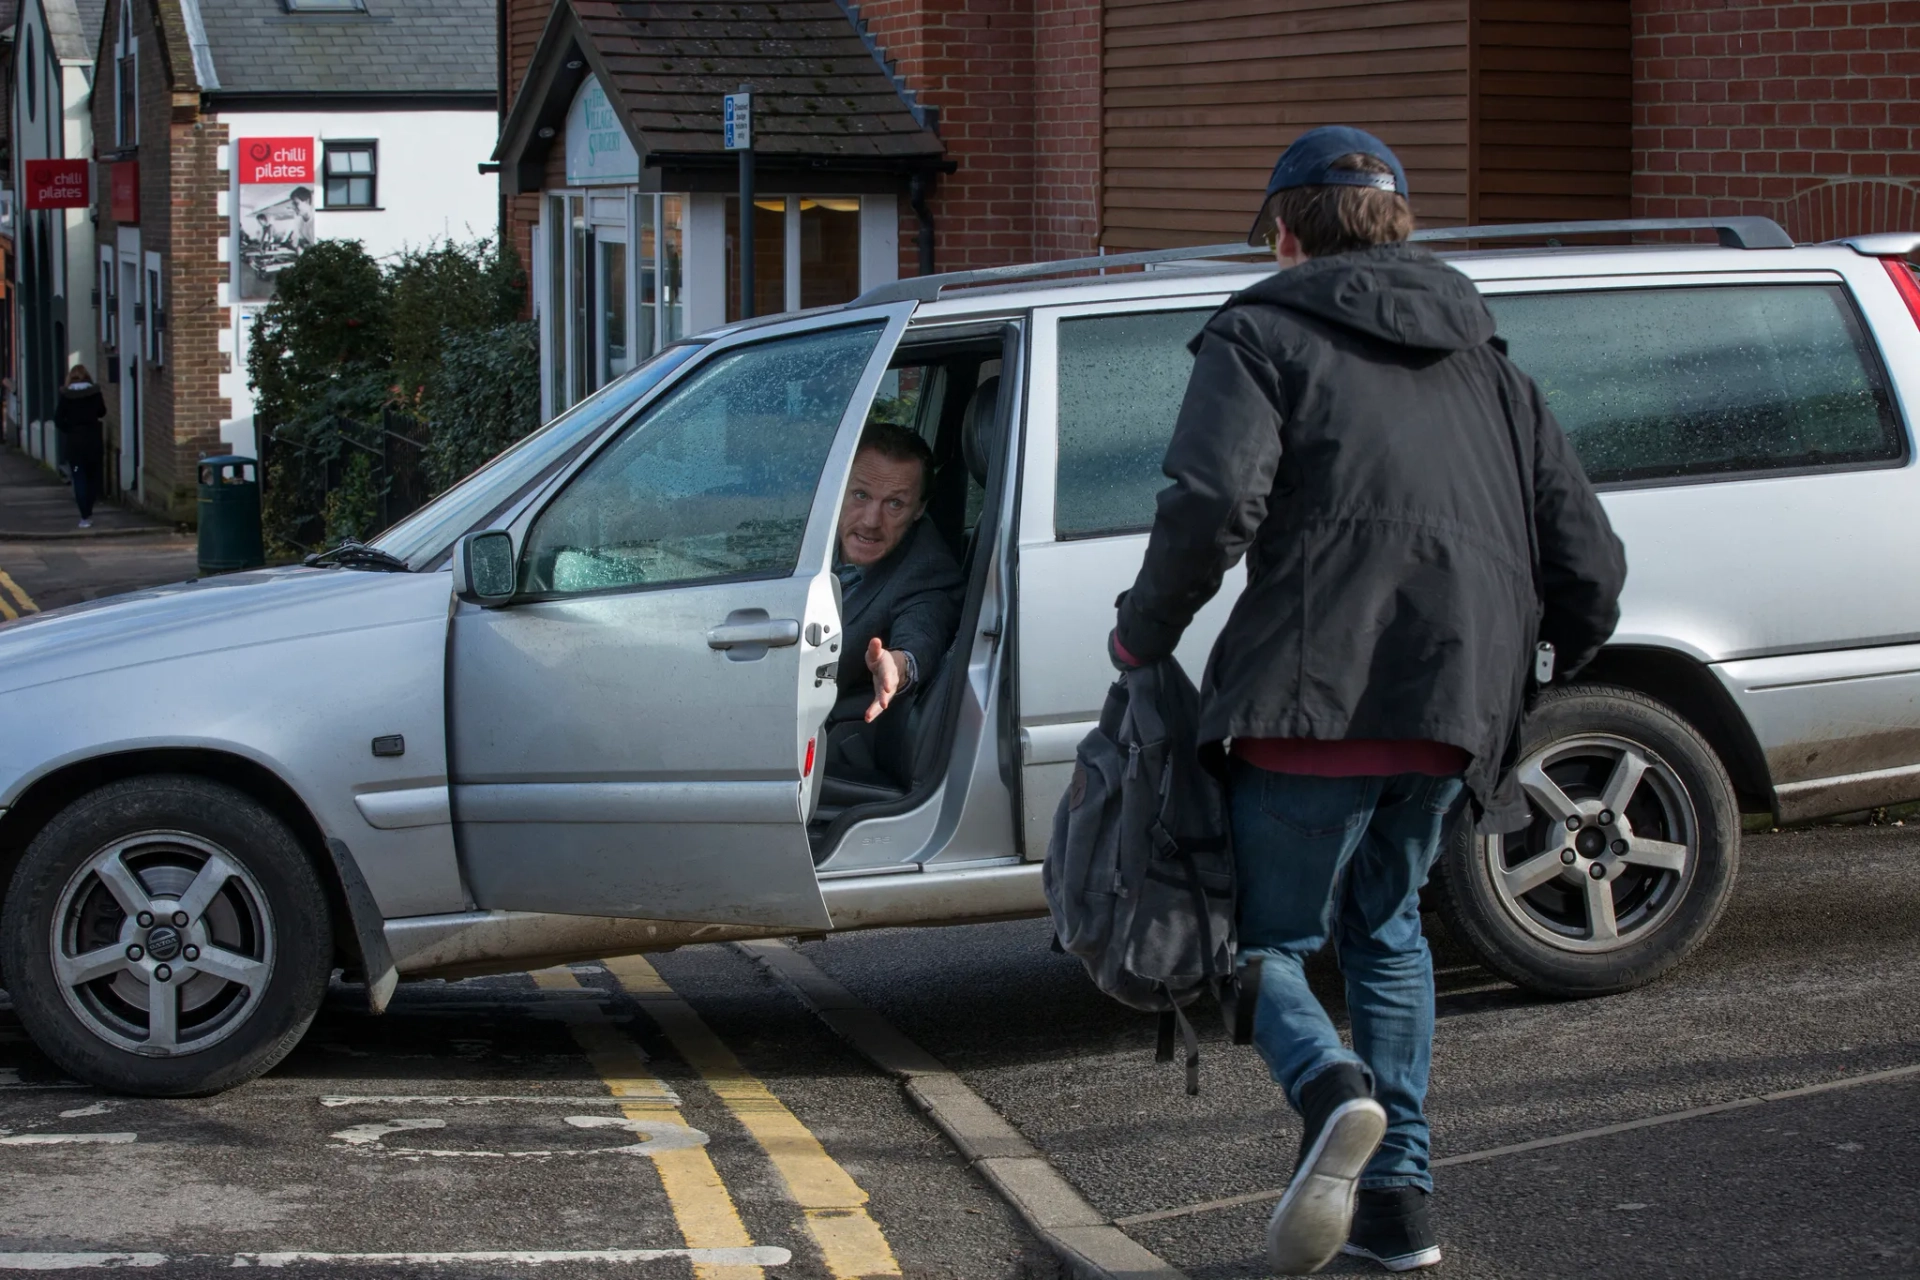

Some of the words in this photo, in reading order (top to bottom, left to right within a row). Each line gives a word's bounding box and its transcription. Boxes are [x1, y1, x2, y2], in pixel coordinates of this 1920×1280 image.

[583, 98, 614, 130] VILLAGE
[727, 100, 733, 120] P
[273, 147, 306, 162] chilli
[588, 131, 621, 167] SURGERY
[54, 172, 83, 185] chilli
[255, 162, 306, 182] pilates
[39, 186, 82, 202] pilates
[149, 938, 177, 949] VOLVO
